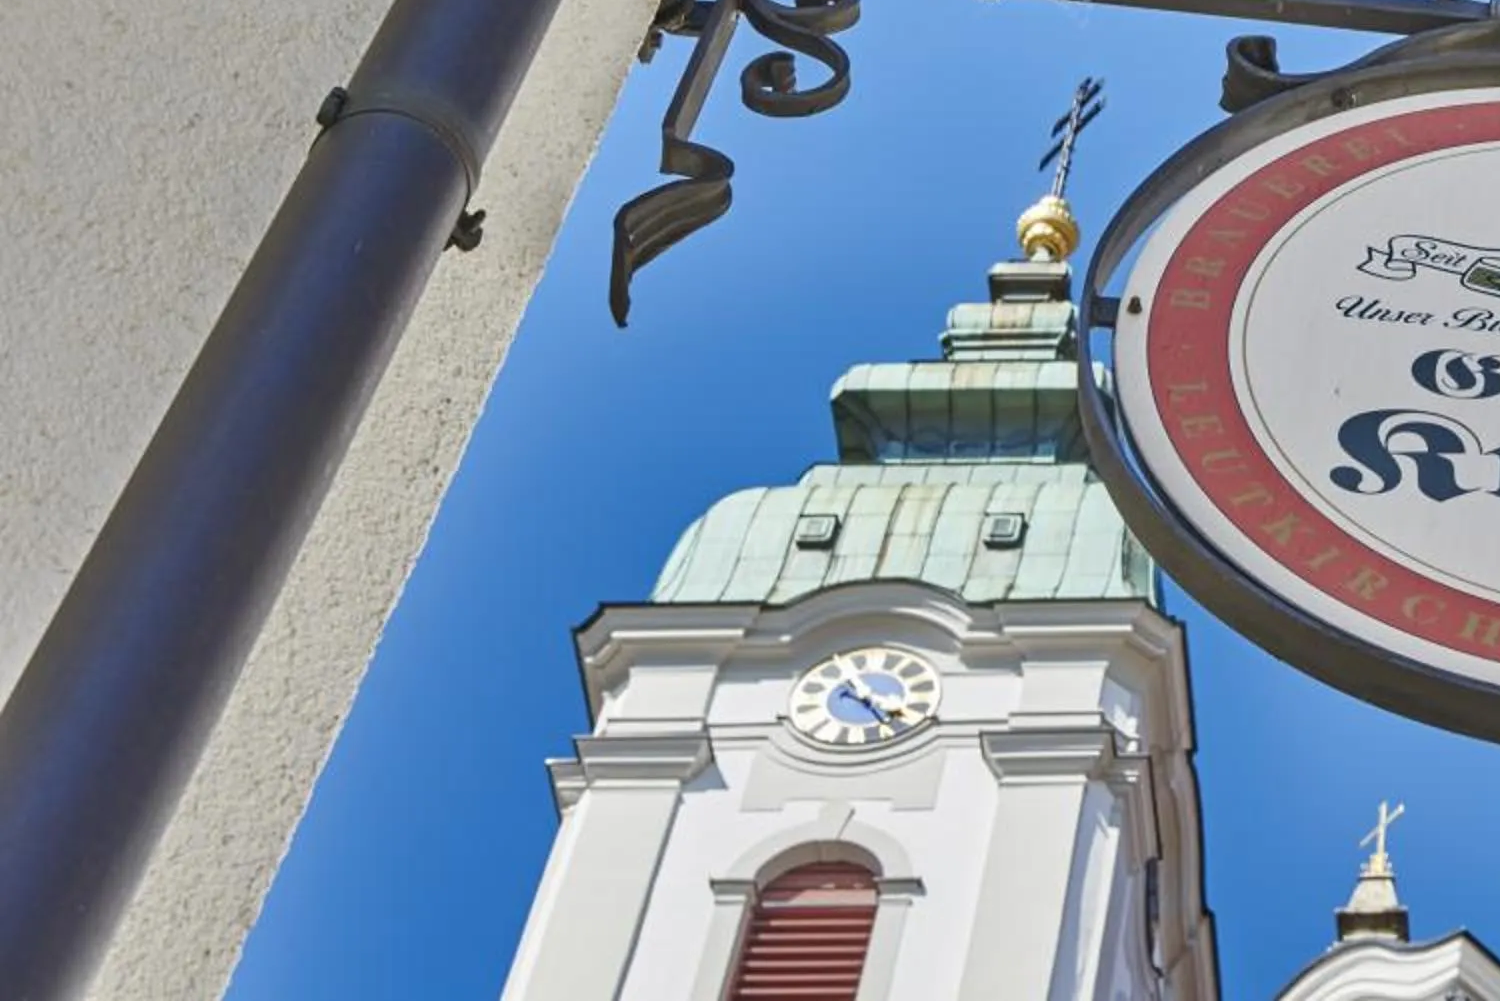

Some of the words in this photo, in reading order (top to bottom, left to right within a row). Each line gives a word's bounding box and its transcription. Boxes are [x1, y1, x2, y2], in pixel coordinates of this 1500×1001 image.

[1169, 125, 1413, 312] BRAUEREI
[1400, 240, 1467, 268] Seit
[1335, 294, 1434, 327] Unser
